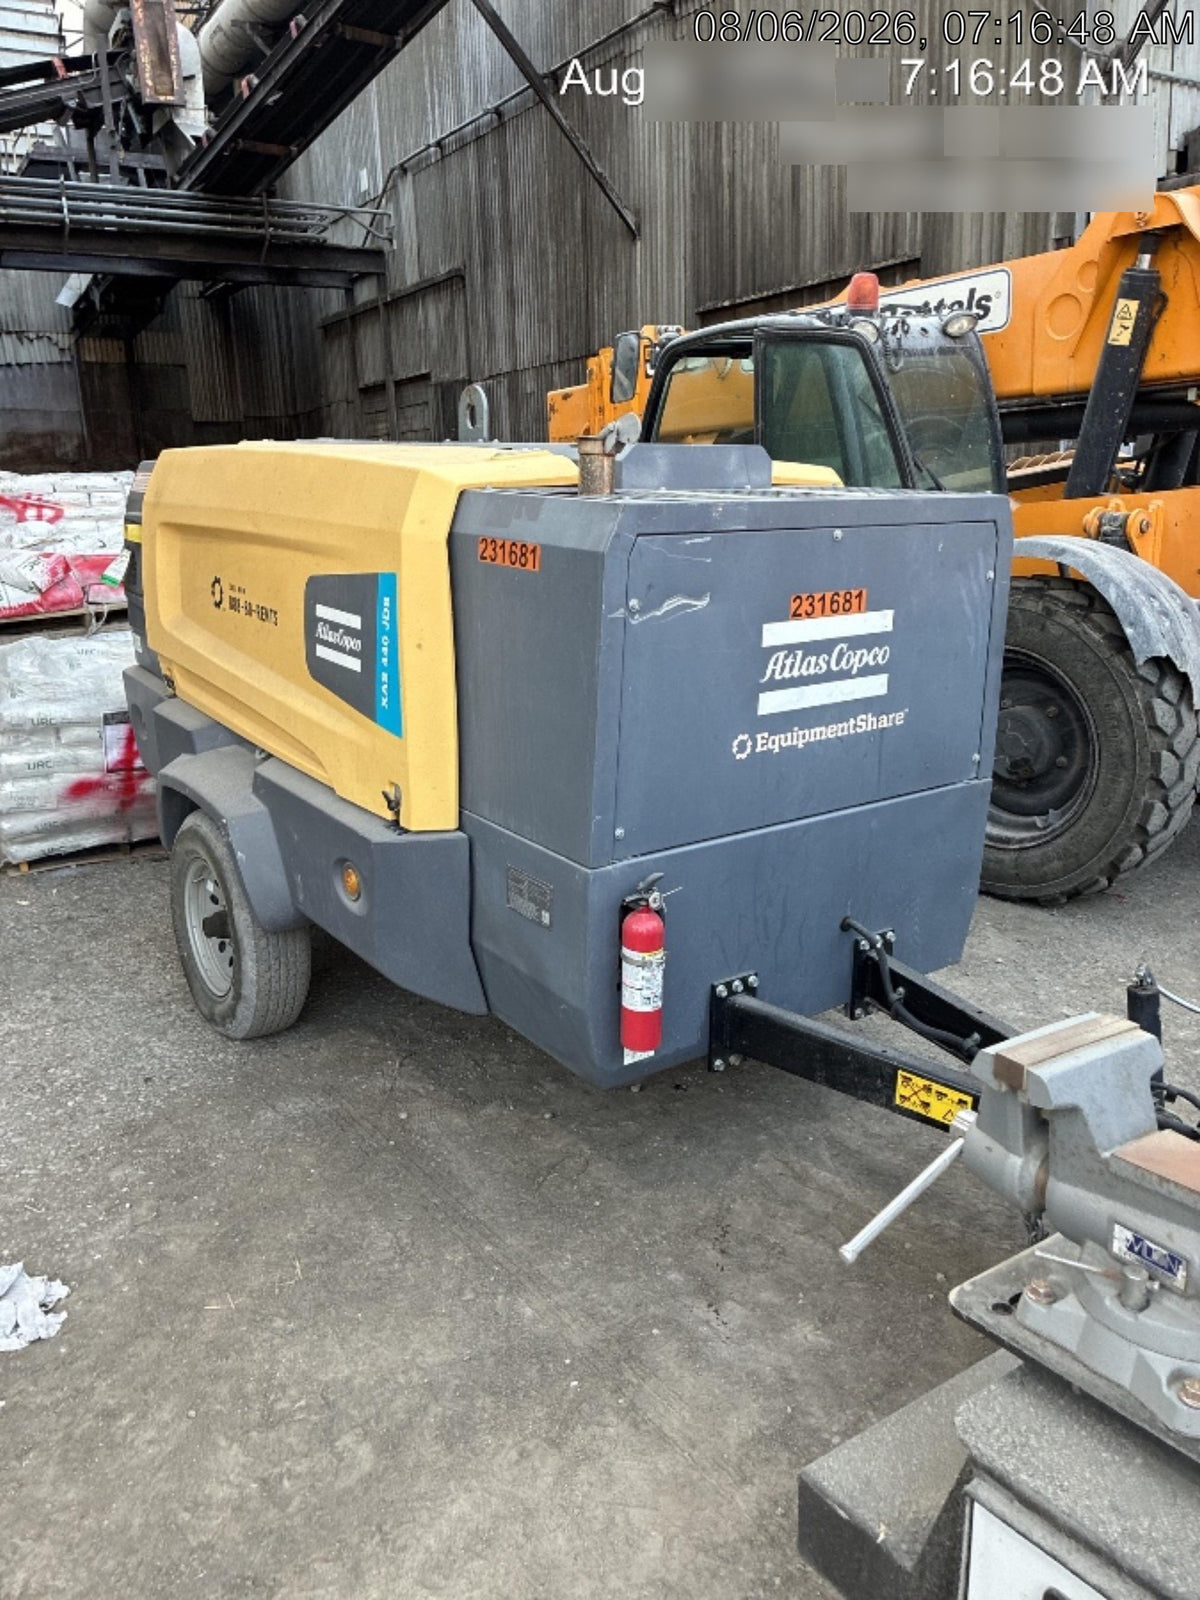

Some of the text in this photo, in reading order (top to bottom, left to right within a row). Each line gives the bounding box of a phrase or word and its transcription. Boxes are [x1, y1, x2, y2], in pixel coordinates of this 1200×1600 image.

[479, 537, 538, 570] 231681
[790, 589, 864, 618] 231681
[755, 711, 905, 754] EquipmentShare
